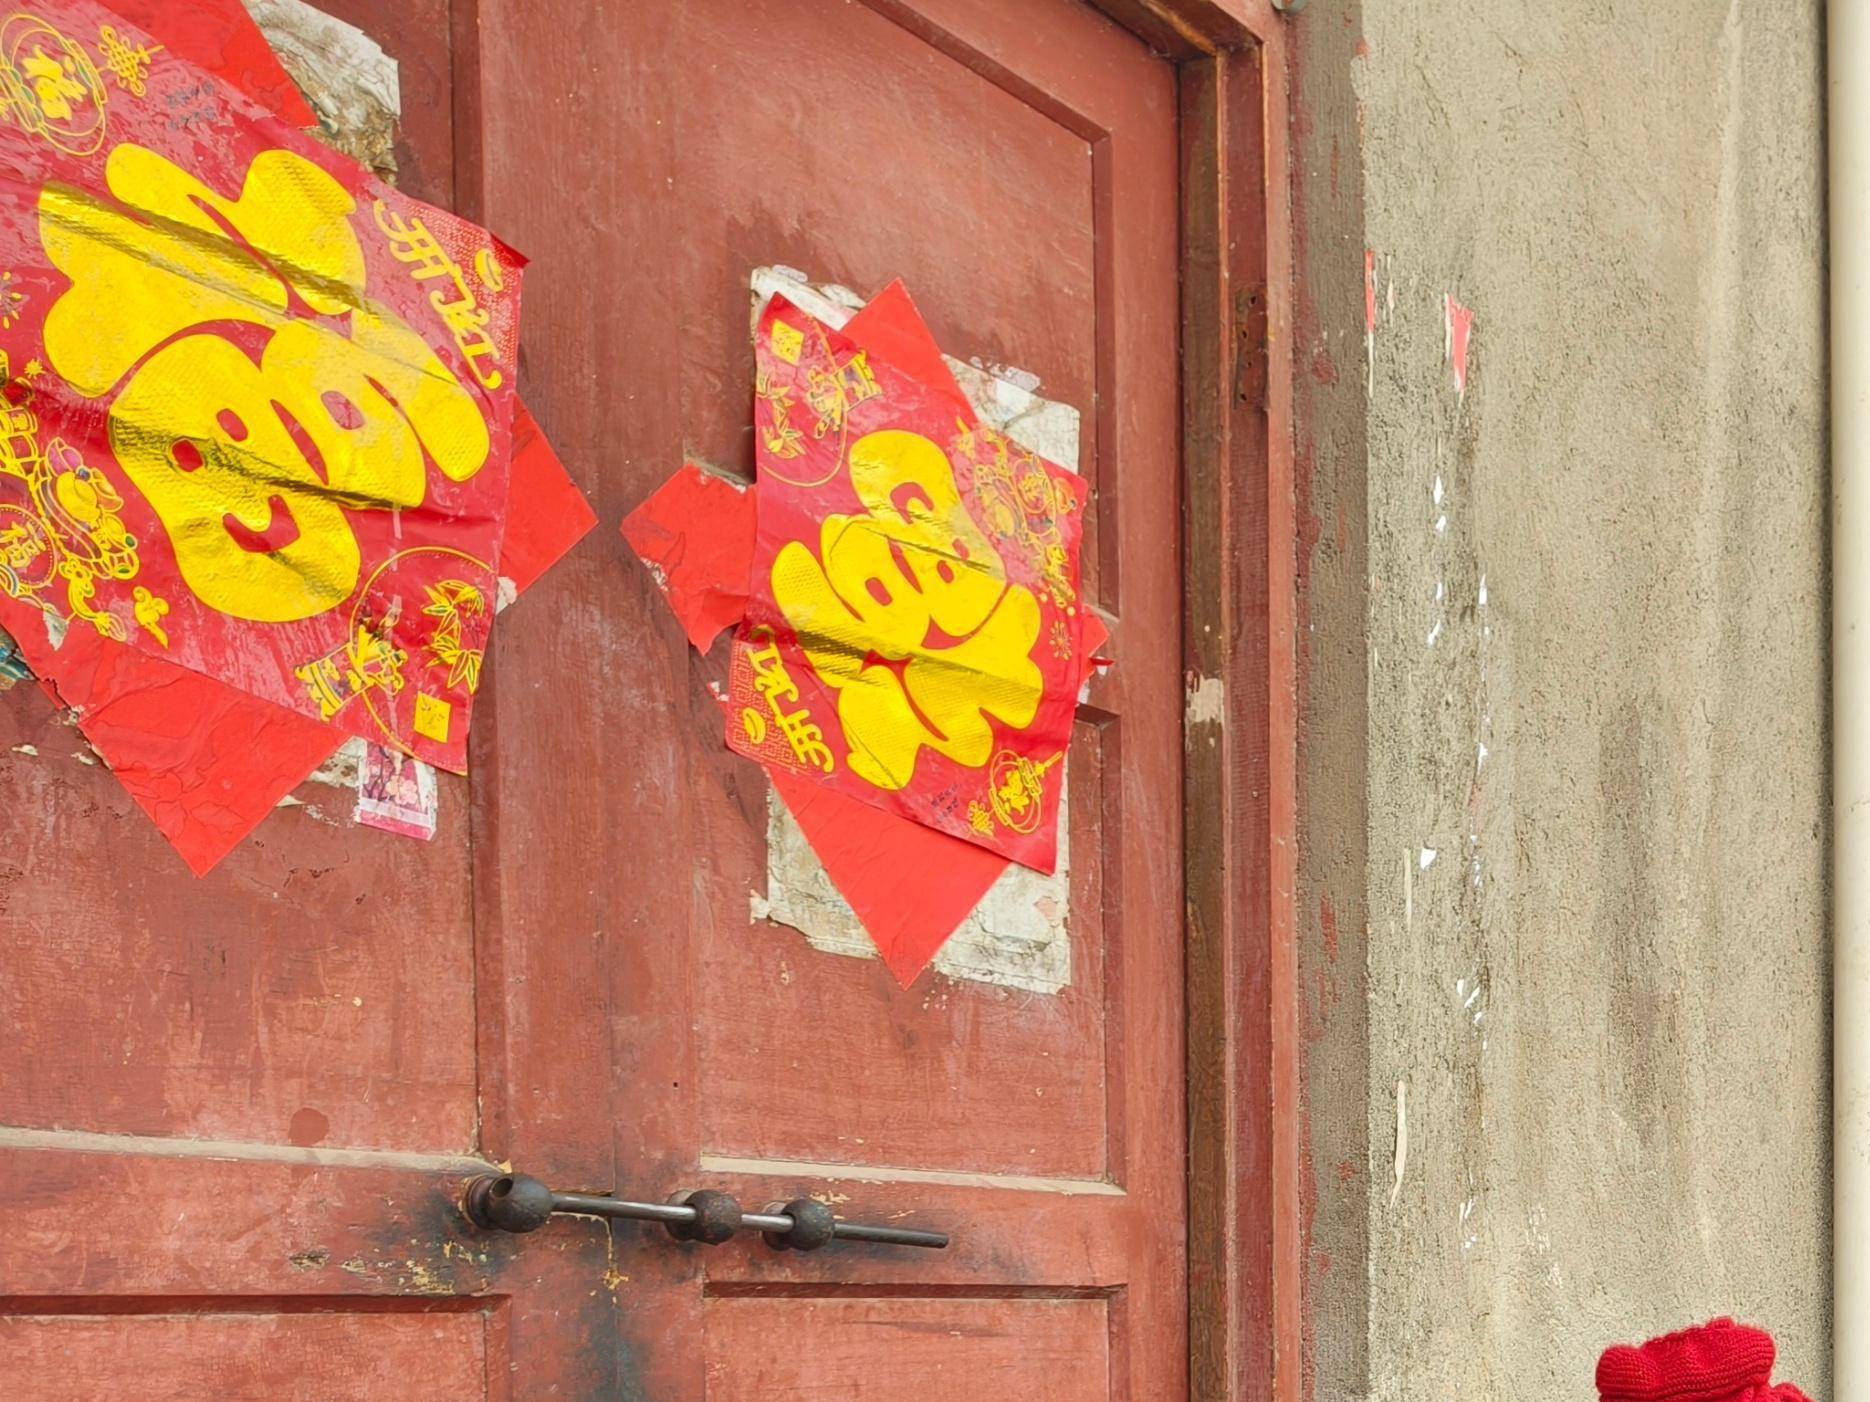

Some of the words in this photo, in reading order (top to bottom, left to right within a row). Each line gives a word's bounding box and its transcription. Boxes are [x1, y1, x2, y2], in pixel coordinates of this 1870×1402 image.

[21, 44, 89, 121] 福
[373, 199, 503, 391] 开门红
[38, 142, 491, 623] 福
[0, 520, 47, 569] 福
[771, 429, 1044, 791] 福
[744, 624, 835, 774] 开门红
